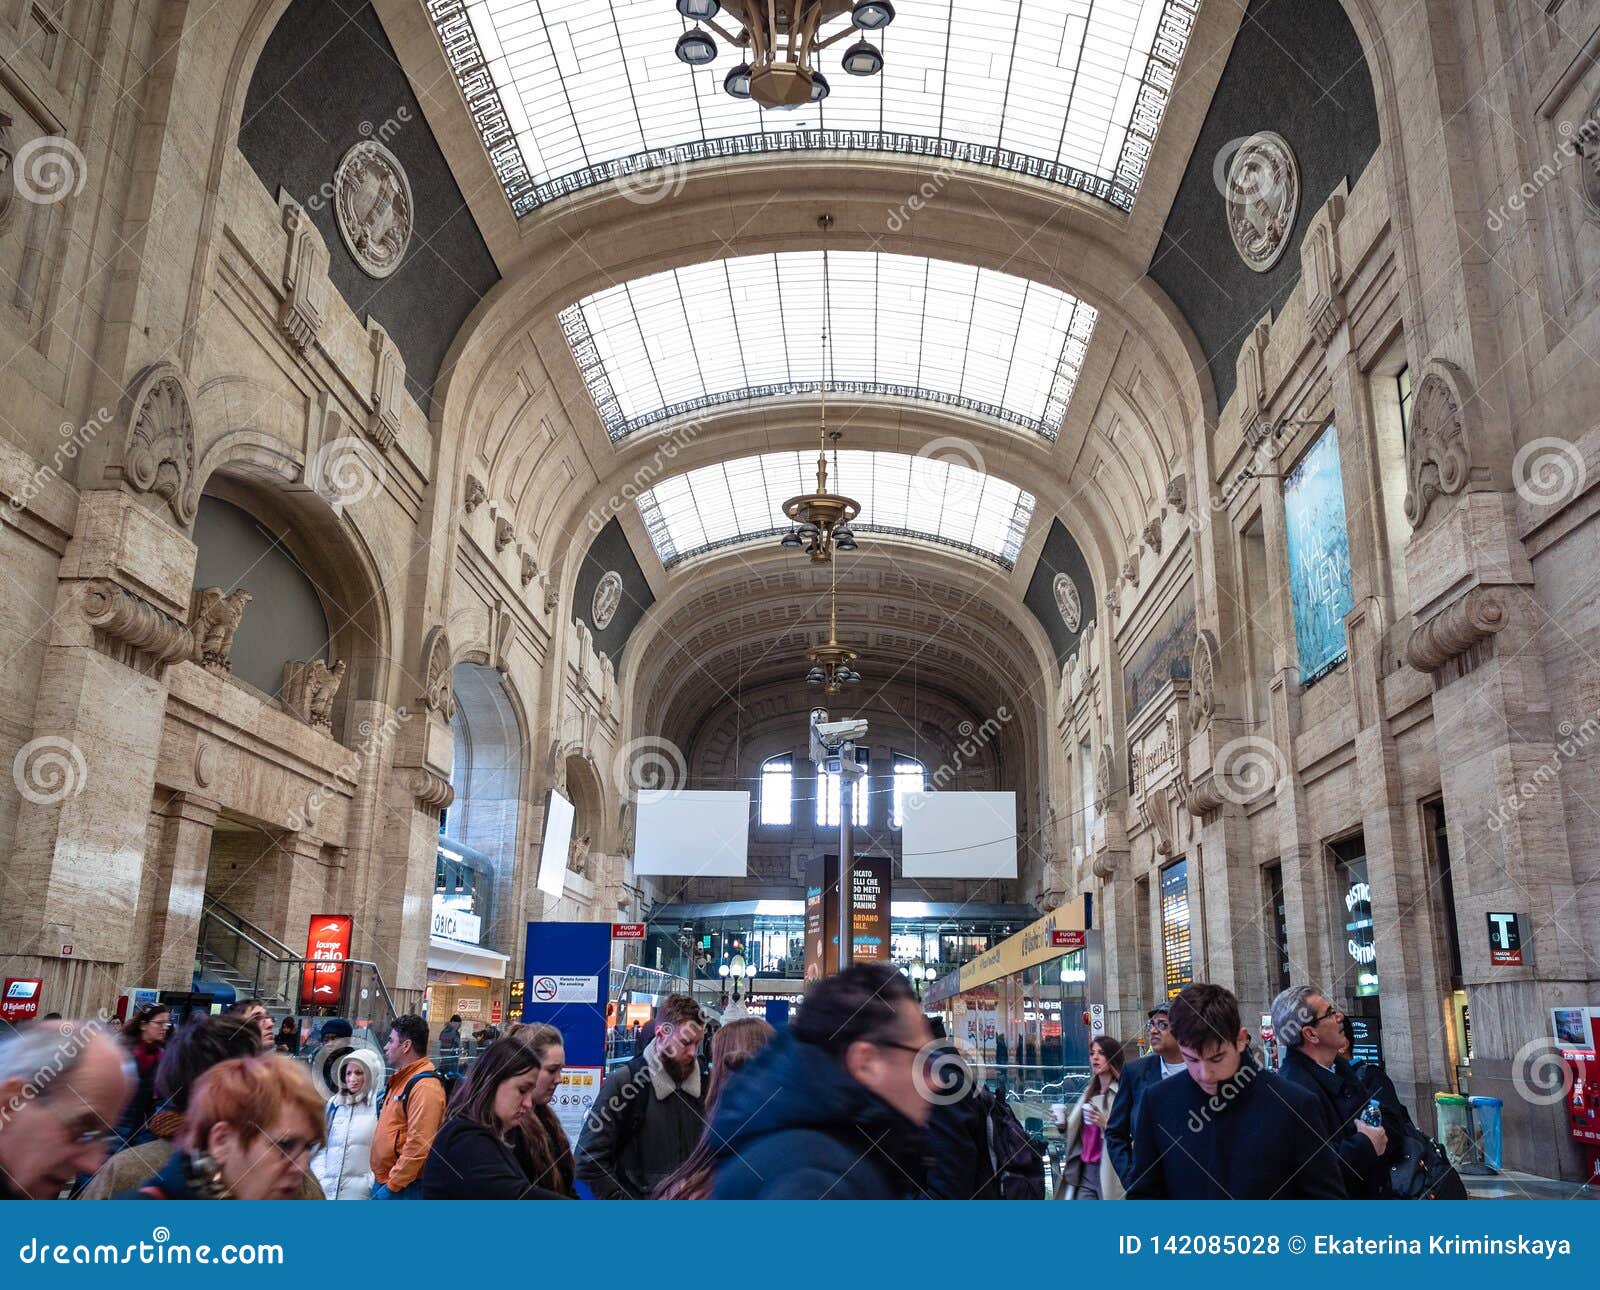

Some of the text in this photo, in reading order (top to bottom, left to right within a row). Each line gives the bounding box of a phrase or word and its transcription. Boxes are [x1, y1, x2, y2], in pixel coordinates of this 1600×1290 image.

[1307, 548, 1342, 608] MEN
[1321, 588, 1342, 630] TE
[314, 949, 343, 961] italo
[316, 940, 342, 951] lounge
